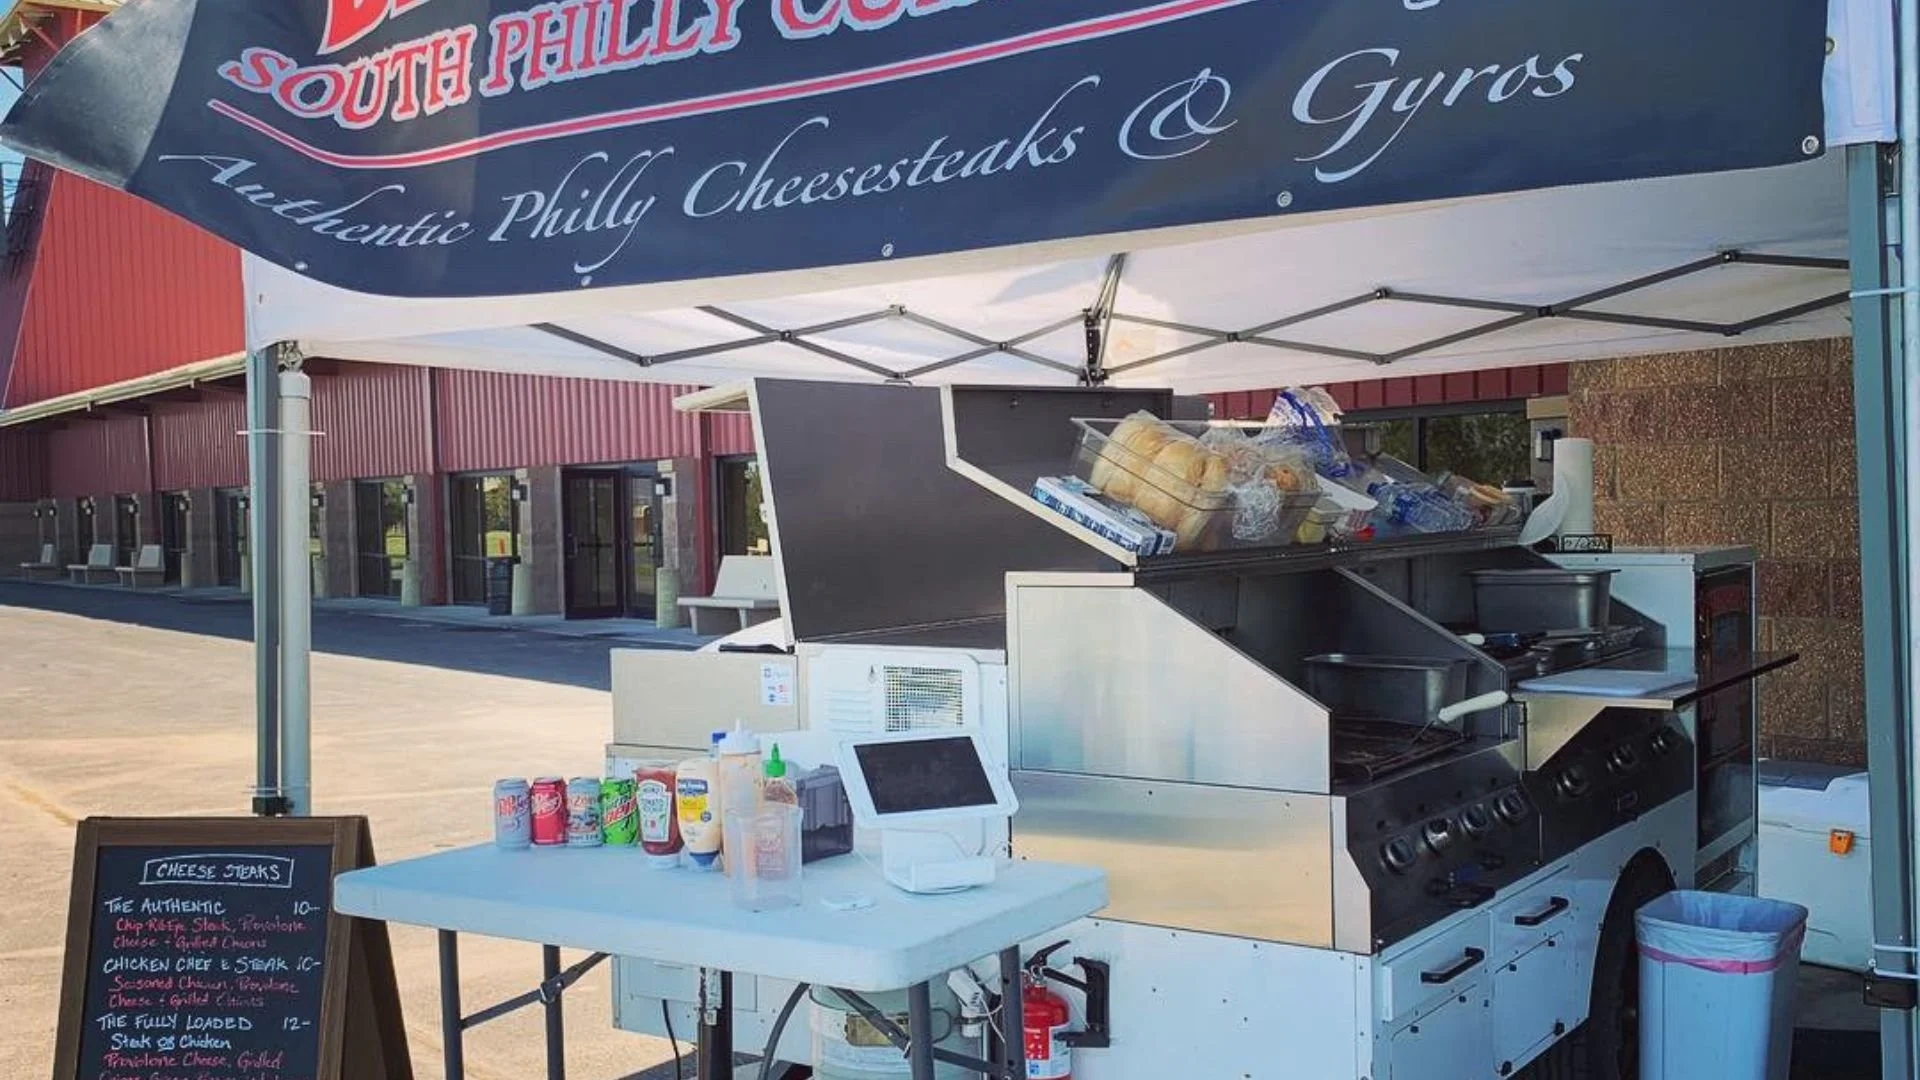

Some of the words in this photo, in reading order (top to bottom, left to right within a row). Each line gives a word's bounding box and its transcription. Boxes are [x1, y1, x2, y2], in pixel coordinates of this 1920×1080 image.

[217, 24, 478, 129] SOUTH
[480, 0, 740, 96] PHILLY
[158, 154, 475, 247] Authentic
[488, 147, 674, 274] Philly
[683, 75, 1101, 218] Cheesesteaks
[1118, 67, 1238, 160] &
[1292, 47, 1583, 183] Gyros
[156, 863, 217, 880] CHEESE
[222, 863, 281, 881] STEAKS
[104, 897, 135, 915] THE
[141, 898, 226, 915] AUTHENTIC
[103, 956, 170, 974] CHICKEN
[234, 956, 289, 974] STEAK
[96, 1014, 127, 1031] THE
[134, 1014, 178, 1030] FULLY
[186, 1015, 253, 1031] LOADED
[111, 1033, 151, 1050] Steak
[179, 1034, 232, 1050] Chicken
